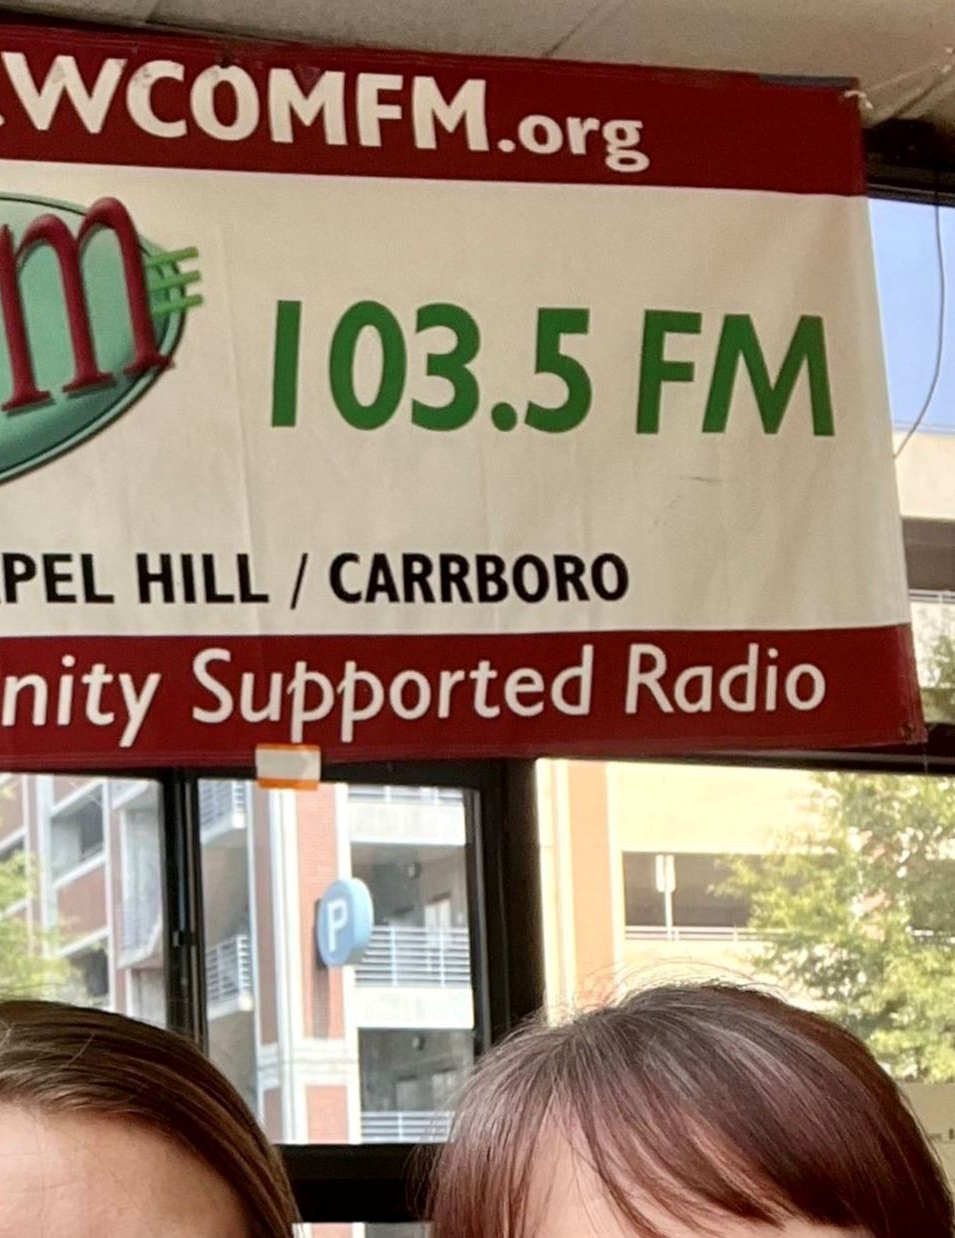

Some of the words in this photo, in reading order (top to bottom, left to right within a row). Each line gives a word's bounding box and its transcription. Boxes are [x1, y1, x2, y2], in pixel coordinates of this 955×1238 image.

[271, 300, 592, 433] 103.5
[636, 309, 835, 437] FM
[137, 553, 269, 603] HILL
[291, 553, 308, 609] /
[330, 552, 629, 603] CARRBORO
[192, 644, 592, 743] Supported
[627, 643, 826, 714] Radio
[326, 899, 348, 952] P
